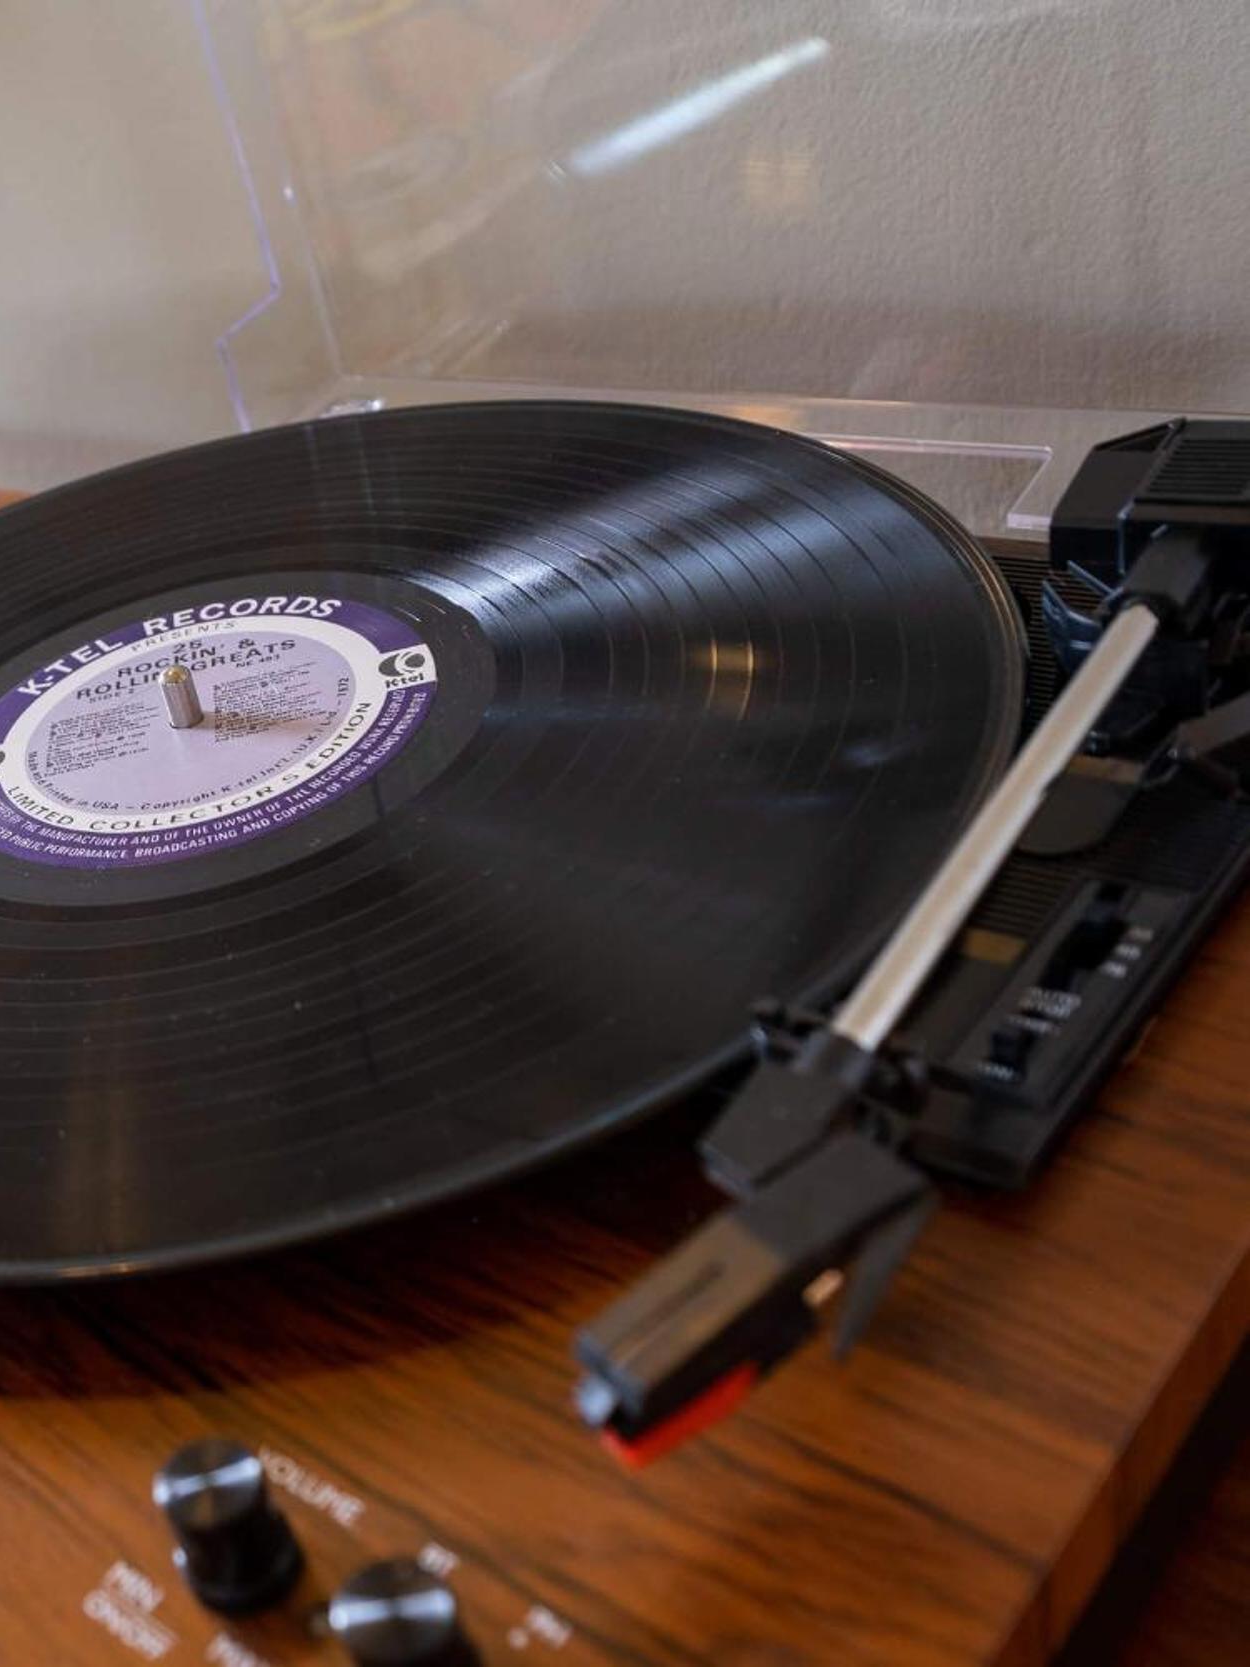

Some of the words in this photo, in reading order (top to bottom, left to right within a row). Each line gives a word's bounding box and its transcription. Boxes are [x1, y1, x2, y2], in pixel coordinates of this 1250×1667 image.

[18, 639, 124, 696] K-TEL
[142, 596, 342, 635] RECORDS
[131, 622, 238, 651] PRESENTS
[172, 639, 203, 654] 25
[238, 639, 256, 650] &
[190, 639, 296, 672] GREATS
[7, 786, 75, 825] LIMITED
[305, 702, 373, 770] EDITION
[39, 827, 127, 846] MANUFACTURER
[130, 834, 160, 845] AND
[164, 831, 180, 841] OF
[185, 826, 210, 838] THE
[213, 809, 263, 831] OWNER
[266, 802, 282, 814] OF
[285, 789, 311, 804] THE
[310, 751, 363, 790] RECORDED
[92, 800, 119, 810] USA
[140, 791, 216, 810] Copyright
[43, 844, 128, 859] PERFORMANCE
[134, 829, 238, 858] BROADCASTING
[242, 818, 271, 834] AND
[273, 791, 330, 822] COPYING
[326, 782, 344, 794] OF
